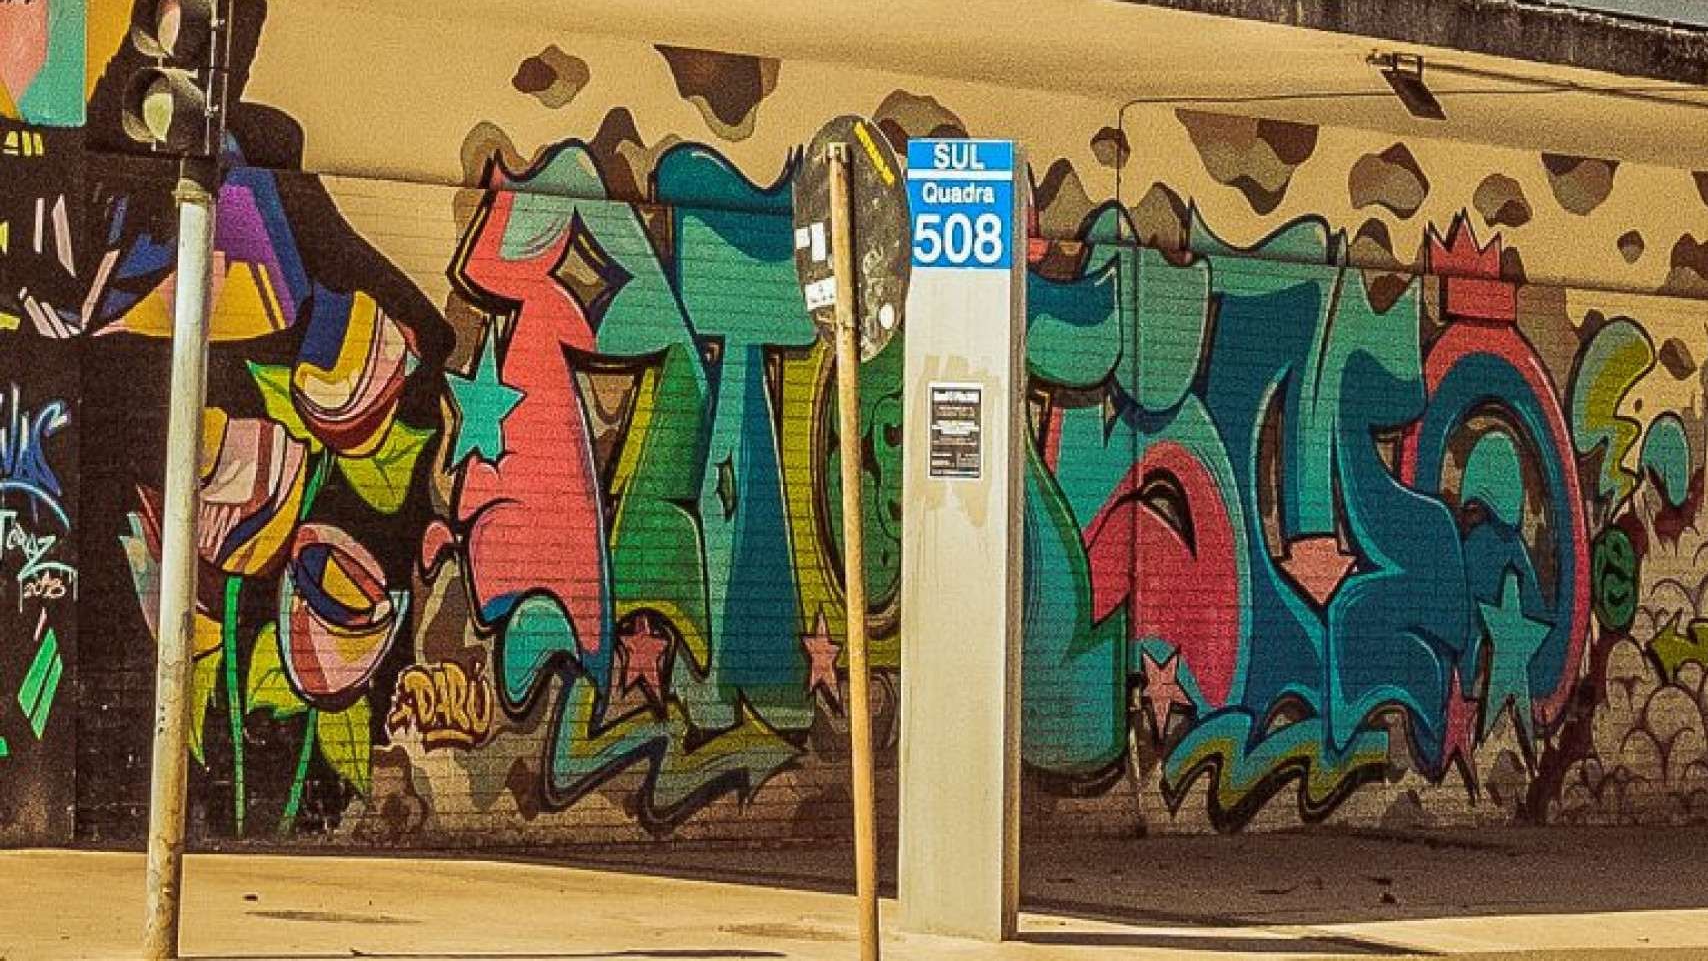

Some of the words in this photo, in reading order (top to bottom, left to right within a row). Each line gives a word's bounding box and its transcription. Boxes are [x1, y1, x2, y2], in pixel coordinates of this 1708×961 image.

[933, 143, 985, 170] SUL
[922, 181, 995, 204] Quadra
[912, 212, 1003, 265] 508
